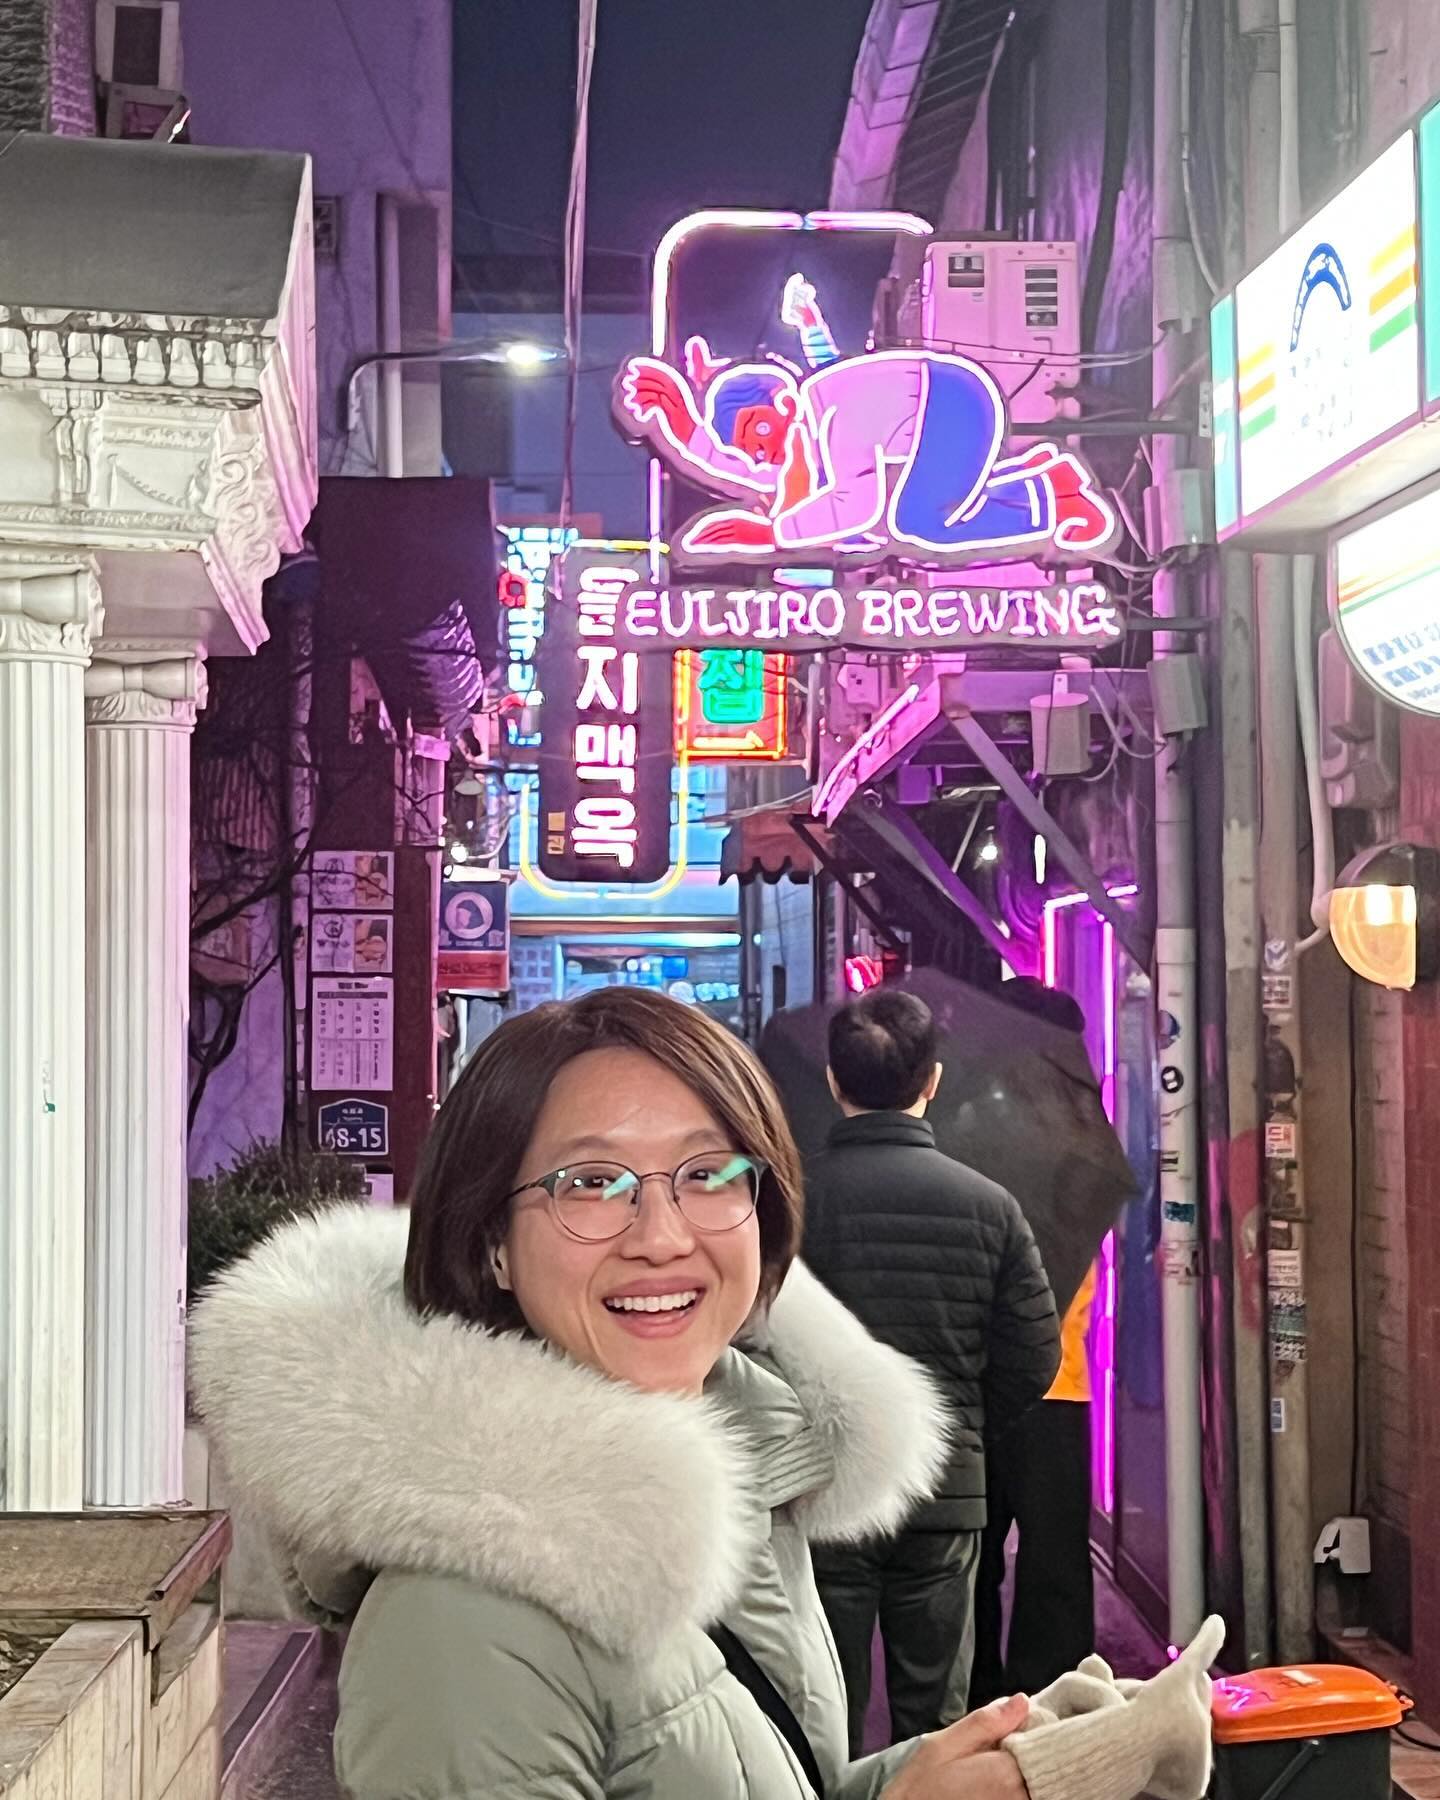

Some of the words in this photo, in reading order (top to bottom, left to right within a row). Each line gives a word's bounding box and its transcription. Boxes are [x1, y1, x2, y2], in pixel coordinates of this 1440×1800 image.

[625, 588, 846, 638] EULJIRO
[855, 584, 1121, 638] BREWING
[571, 566, 639, 868] 을지맥옥
